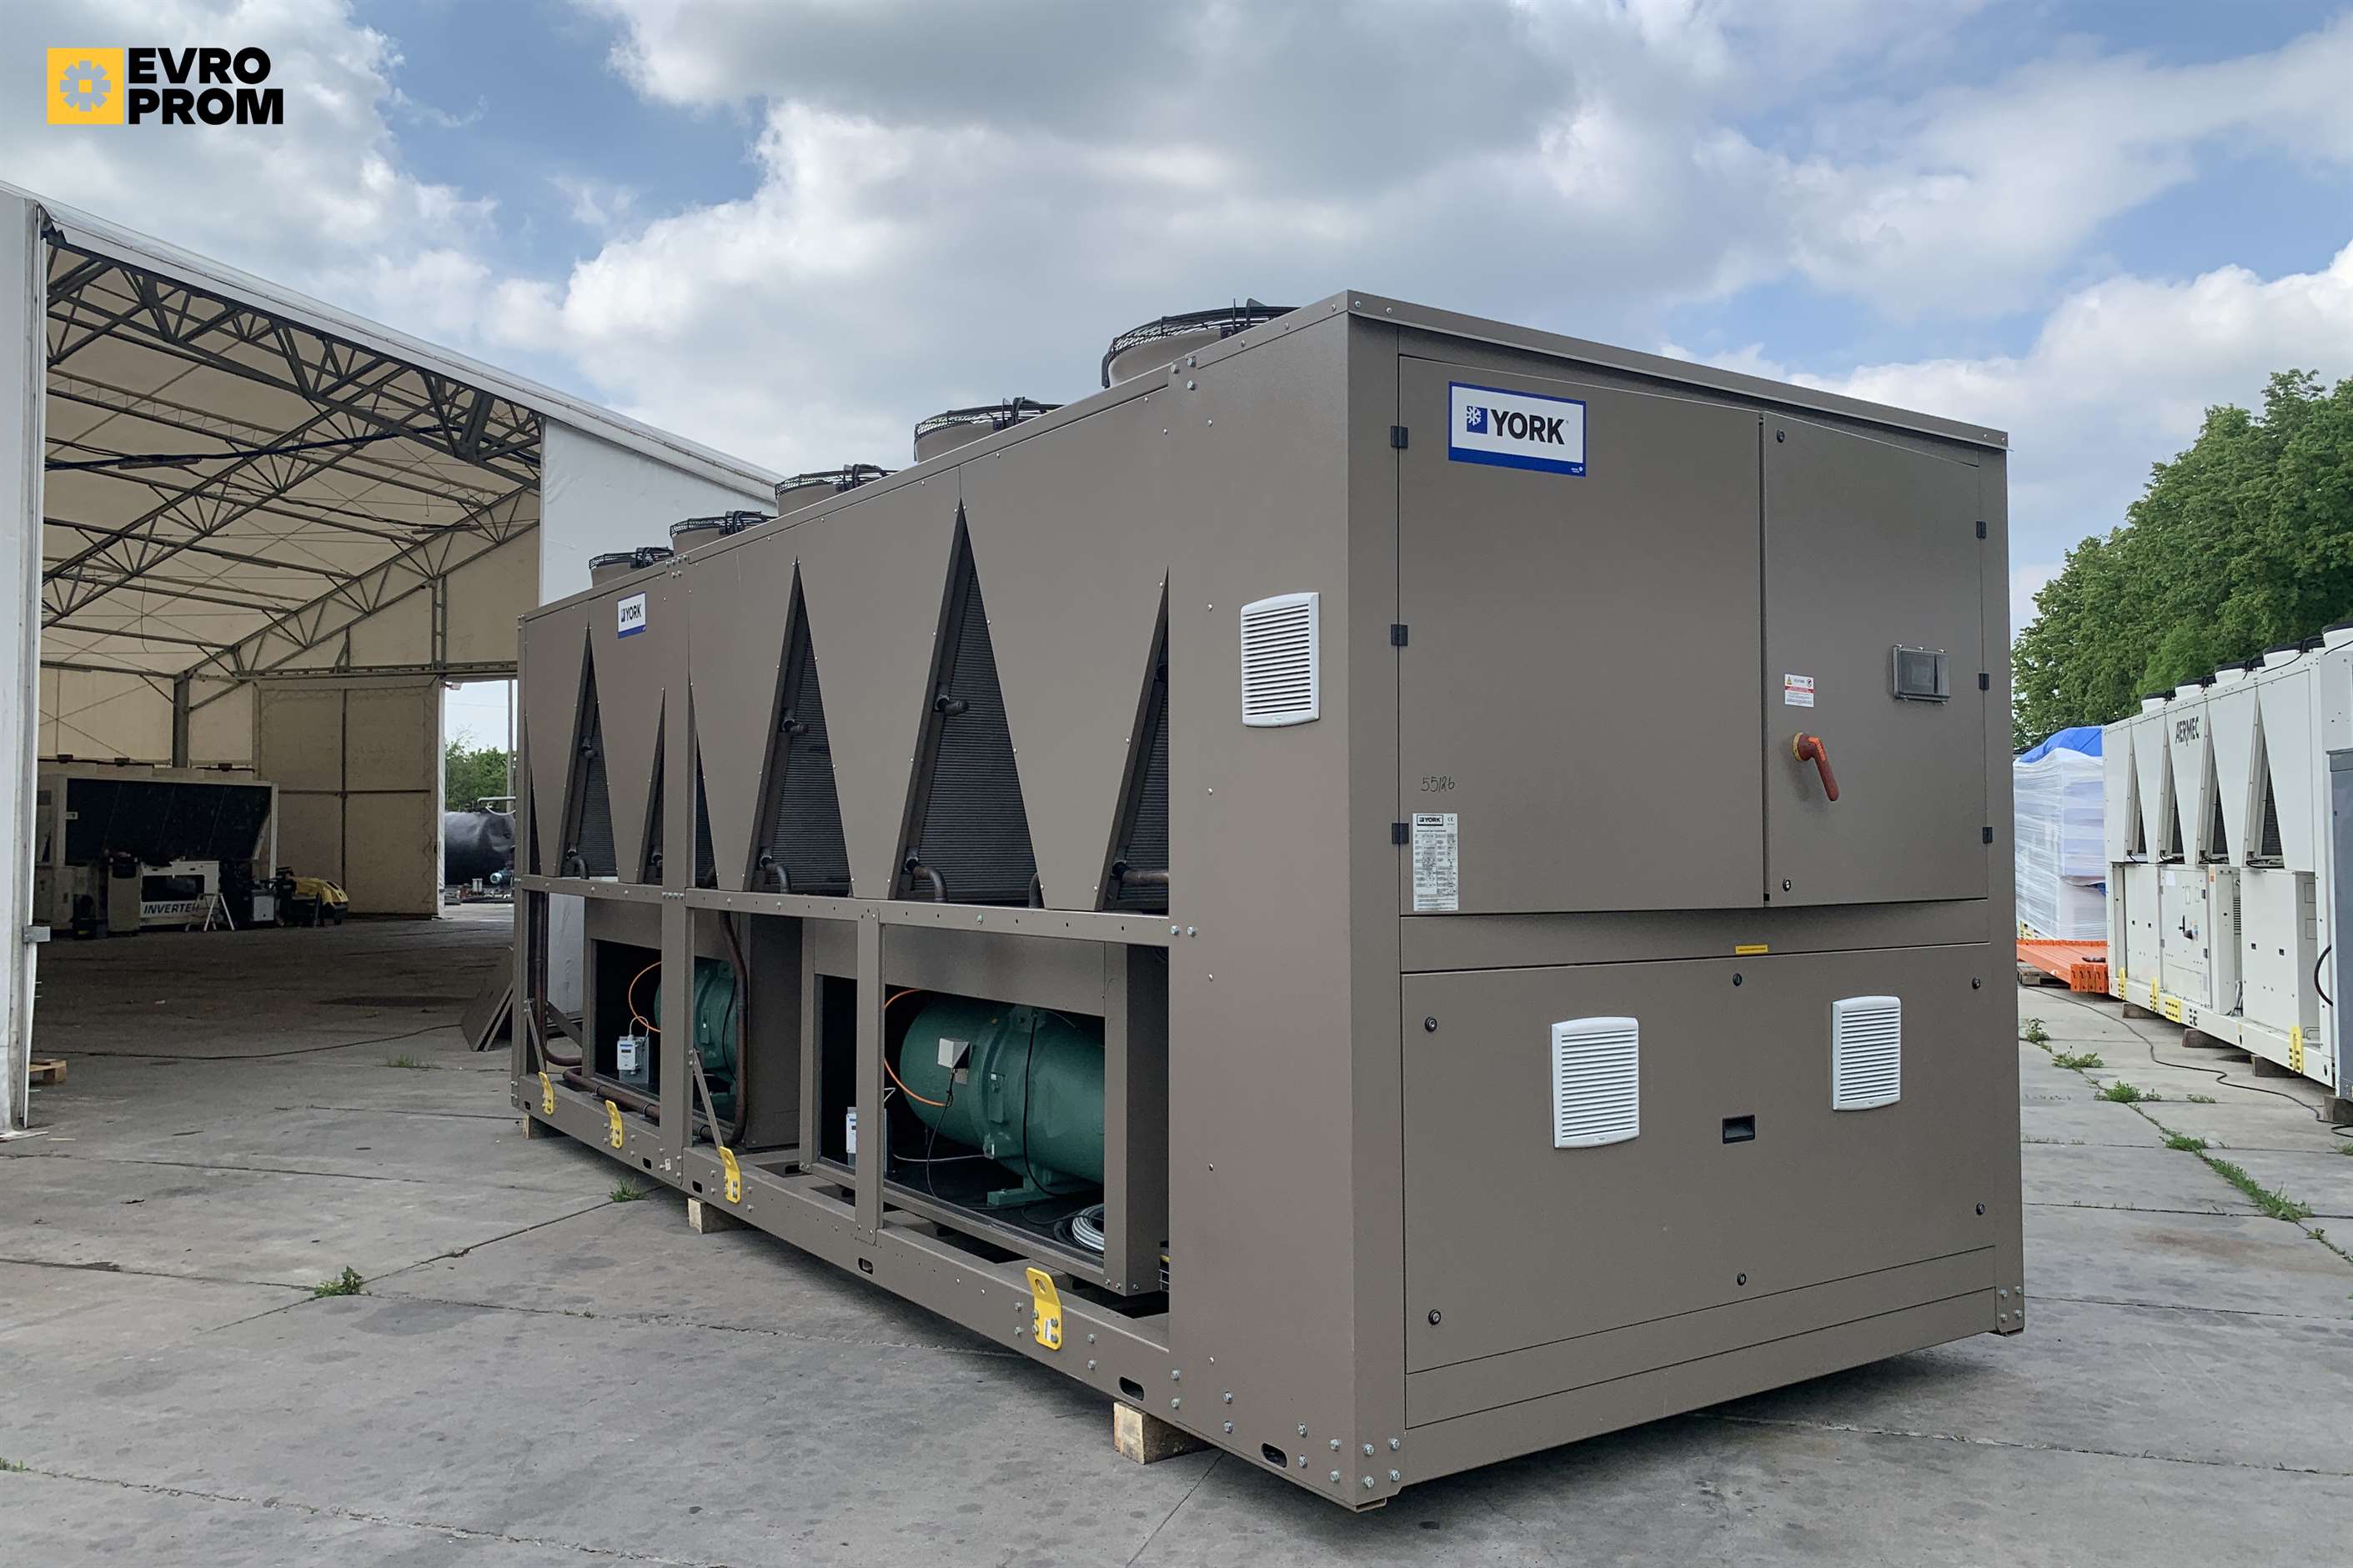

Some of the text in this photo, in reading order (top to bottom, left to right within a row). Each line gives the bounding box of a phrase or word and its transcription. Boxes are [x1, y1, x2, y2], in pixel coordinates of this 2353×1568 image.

[1491, 408, 1564, 444] YORK
[625, 604, 641, 621] YORK
[2175, 716, 2199, 746] AERMEC
